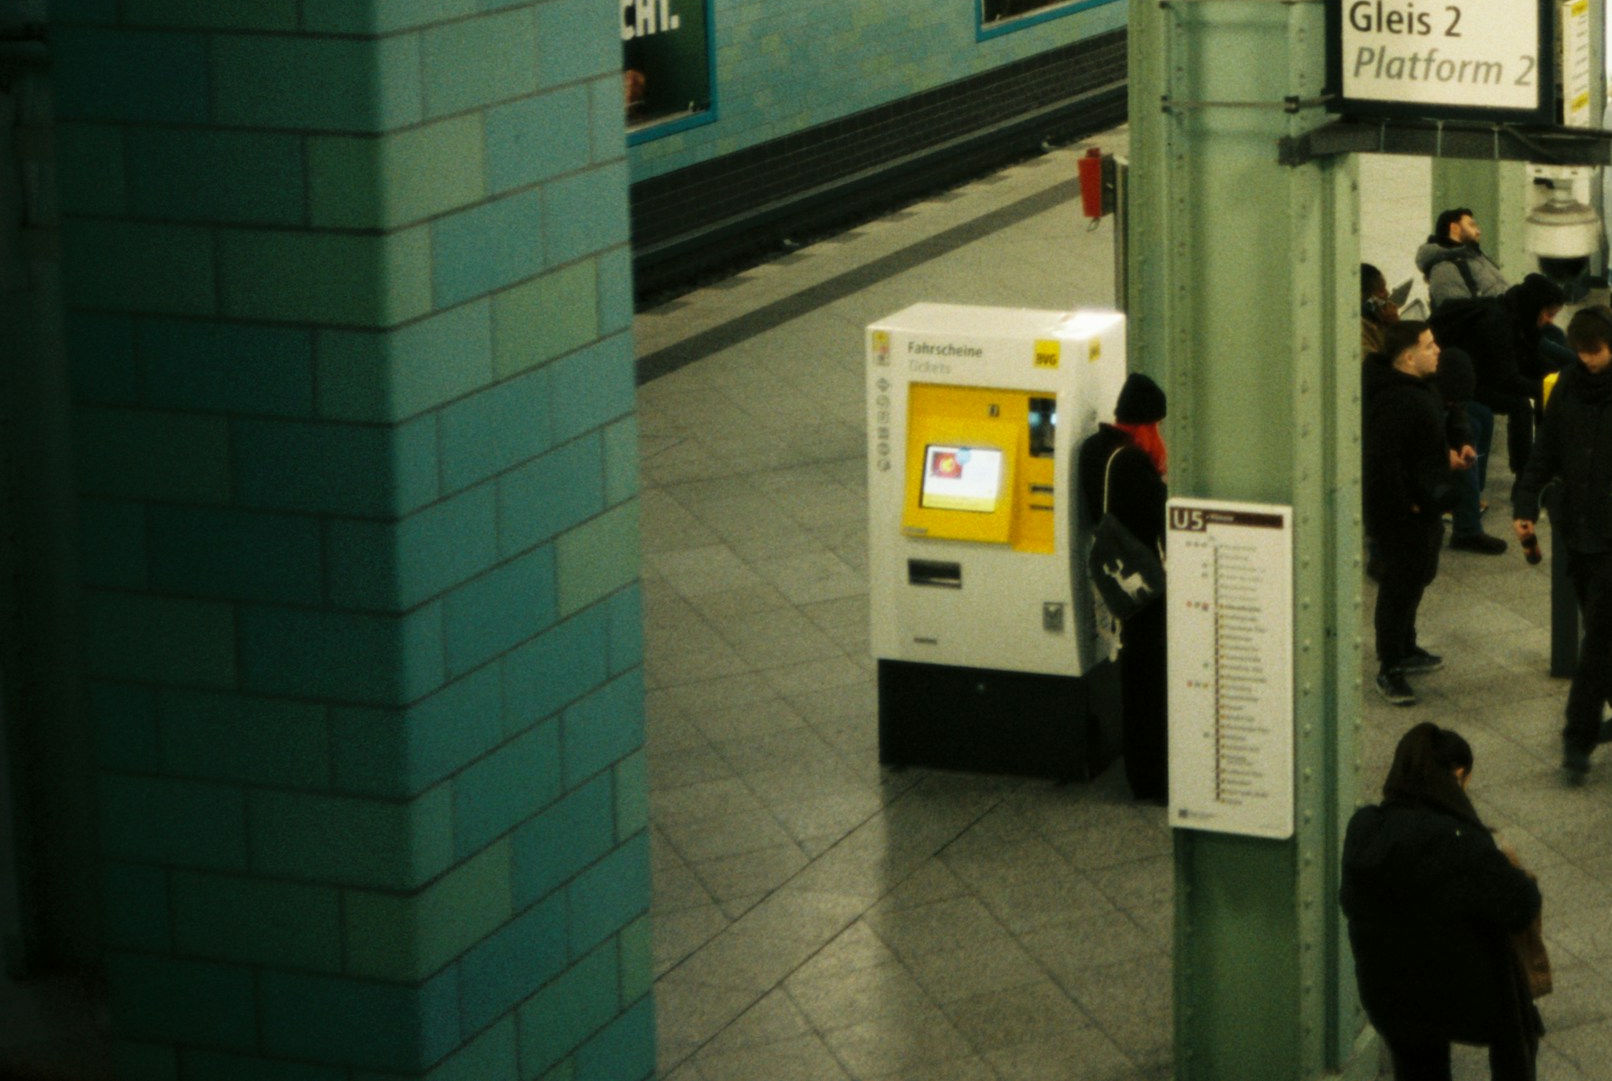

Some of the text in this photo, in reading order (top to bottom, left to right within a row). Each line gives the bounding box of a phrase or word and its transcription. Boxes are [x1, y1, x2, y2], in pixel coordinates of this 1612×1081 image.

[1350, 0, 1463, 38] Gleis 2
[1353, 45, 1504, 85] Platform
[1513, 54, 1536, 87] 2
[907, 341, 1057, 366] Fahrscheine BVG
[909, 360, 951, 375] Tickets
[1173, 509, 1205, 531] U5
